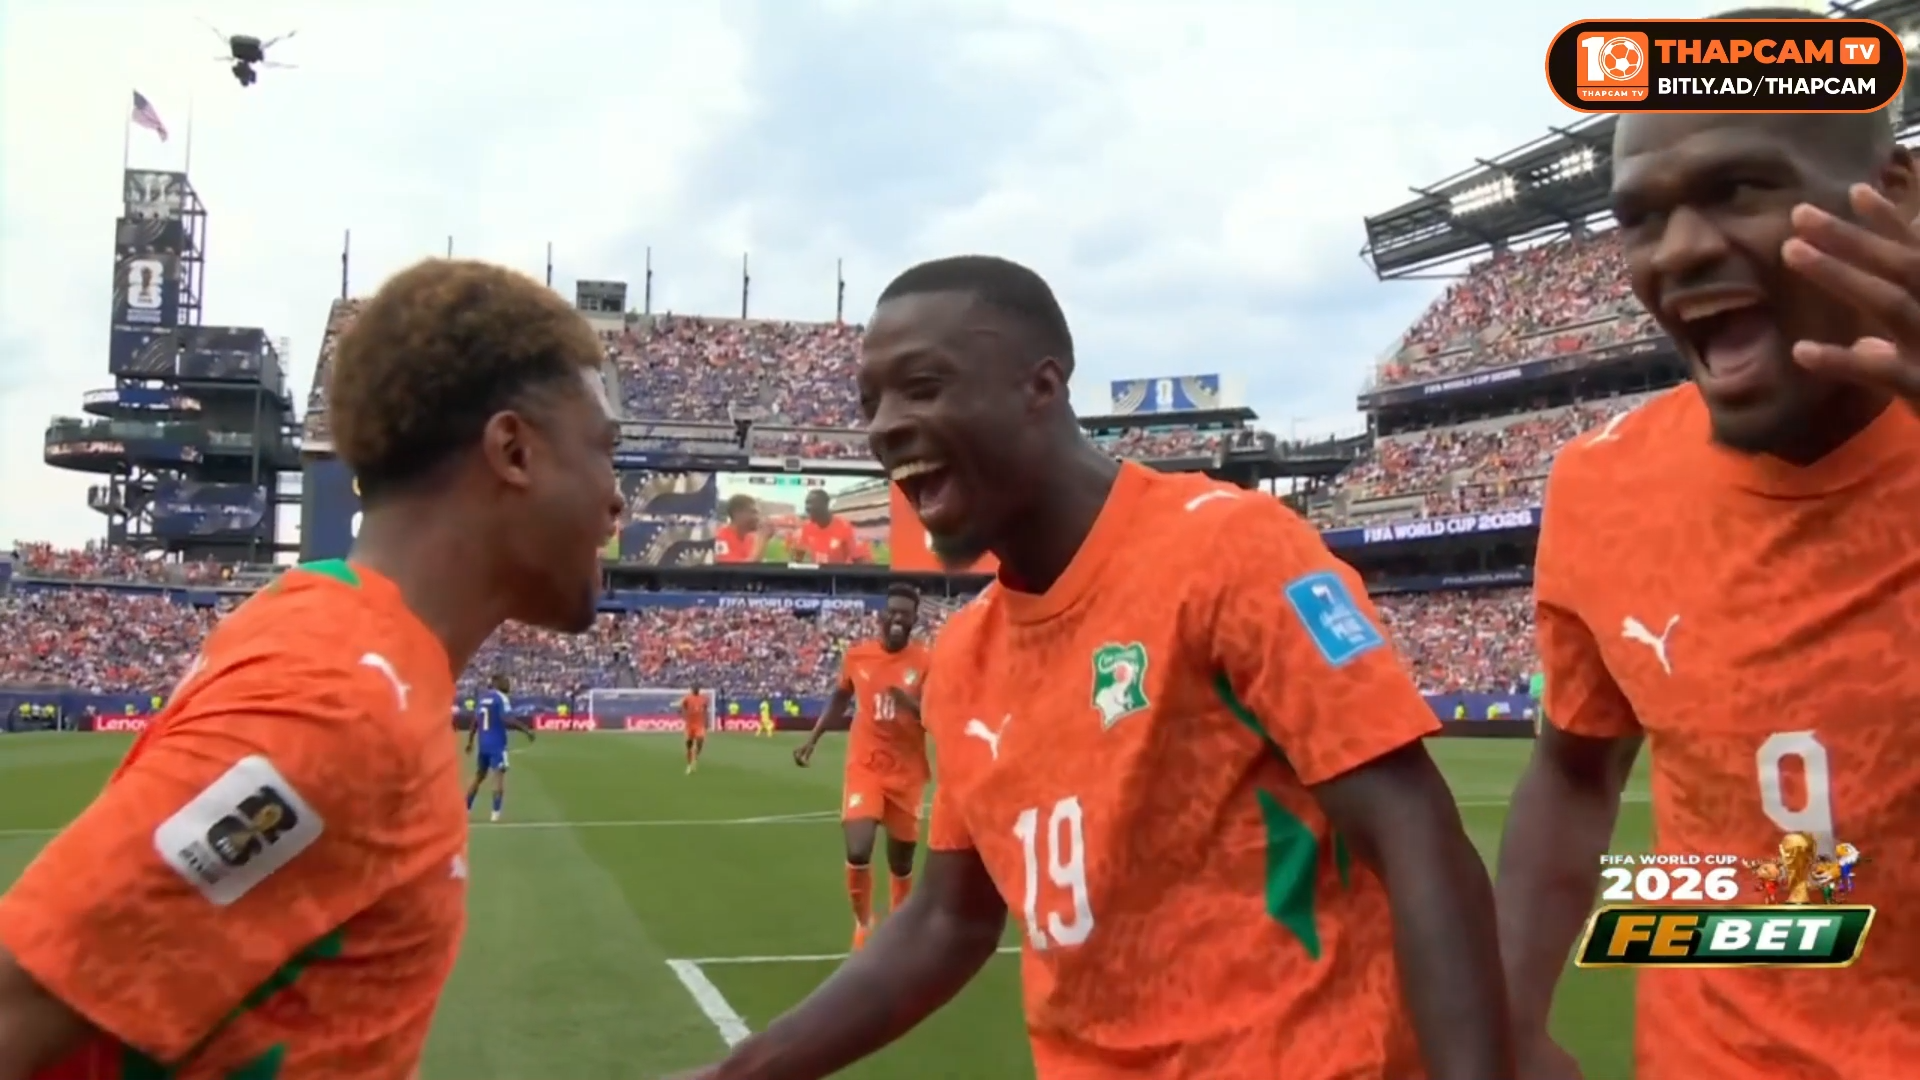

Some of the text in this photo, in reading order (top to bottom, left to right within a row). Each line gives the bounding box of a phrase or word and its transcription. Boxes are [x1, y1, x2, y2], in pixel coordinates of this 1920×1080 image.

[1364, 510, 1532, 543] FIFA WORLD CUP 2026
[1012, 796, 1094, 951] 19
